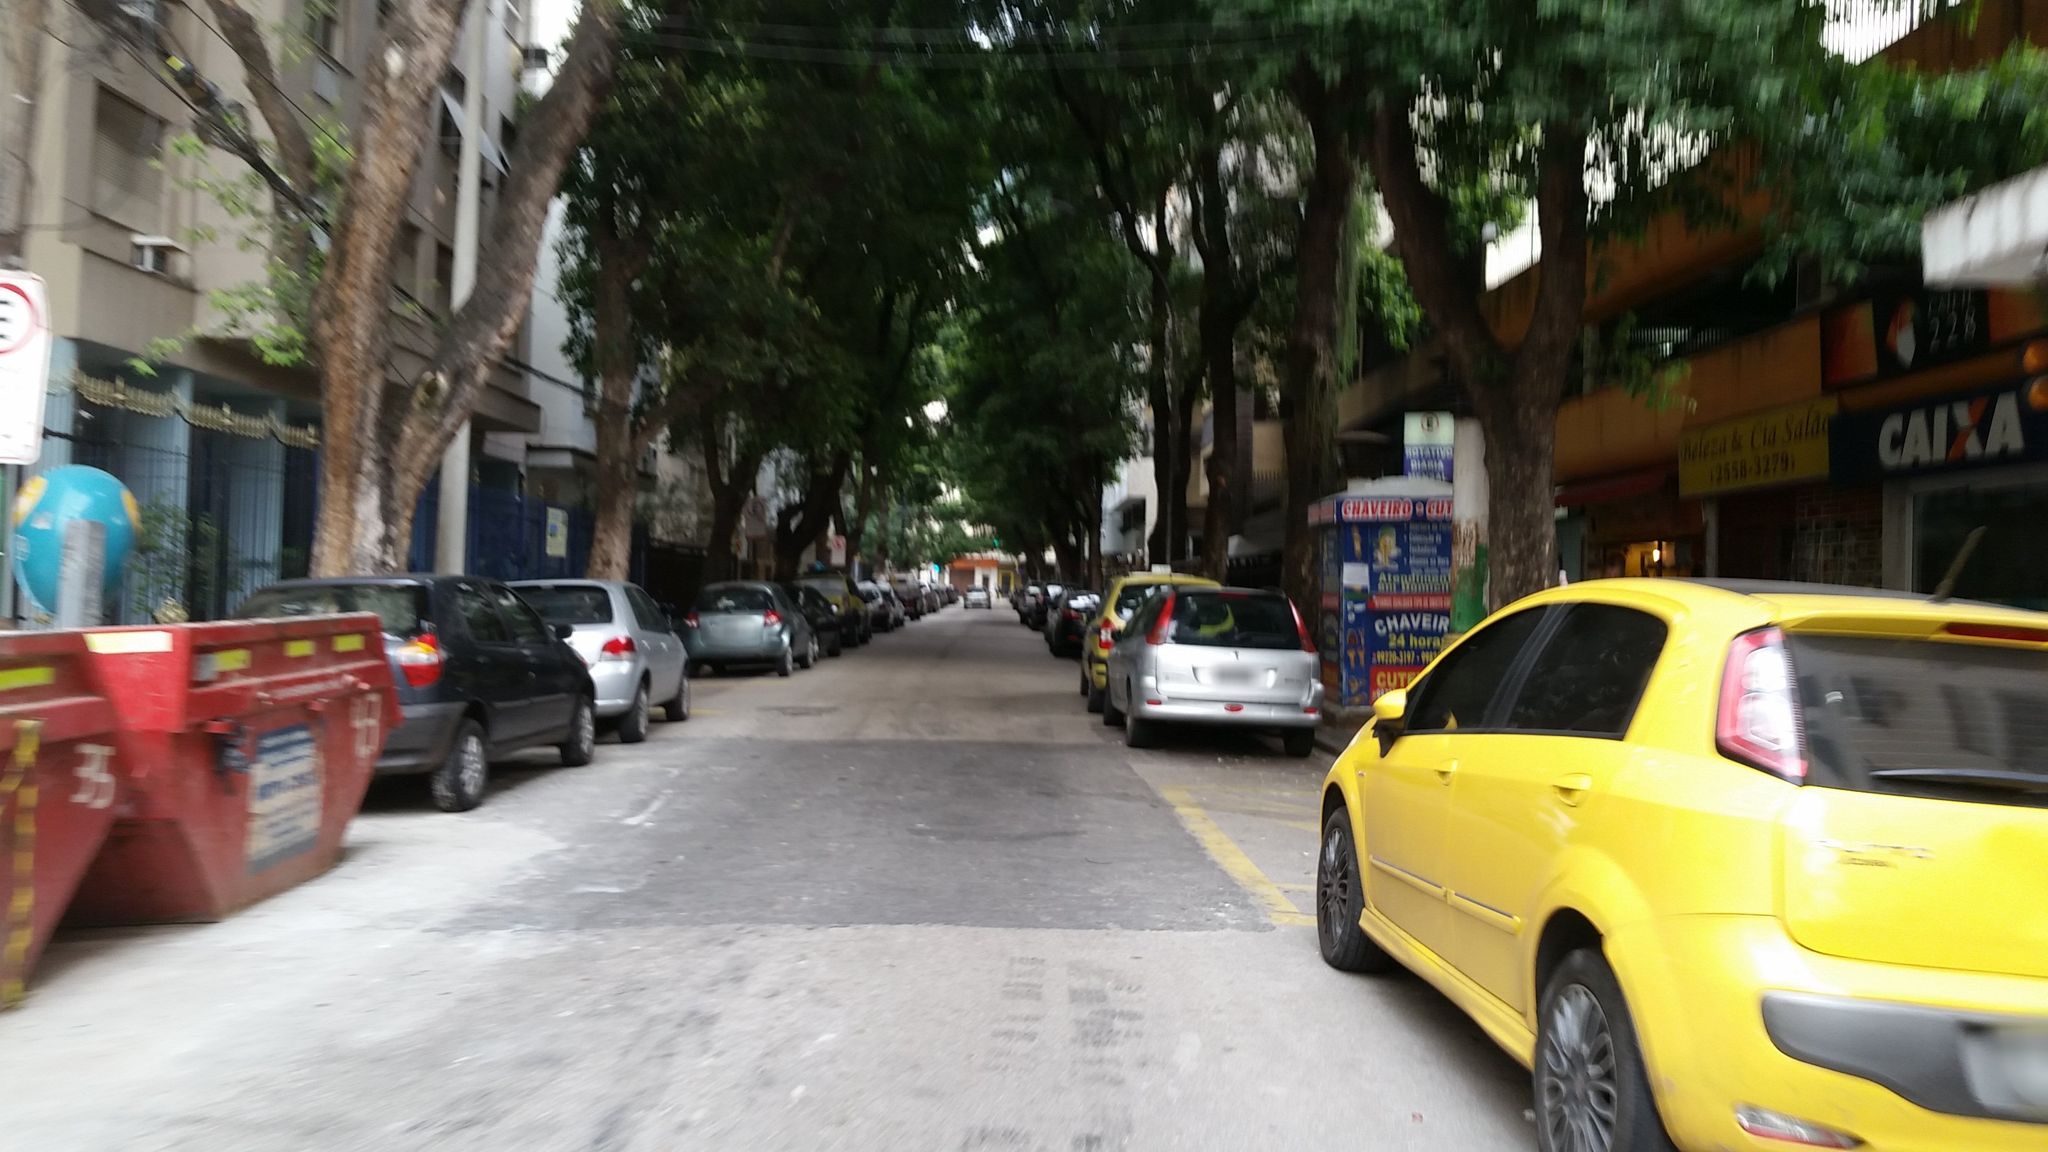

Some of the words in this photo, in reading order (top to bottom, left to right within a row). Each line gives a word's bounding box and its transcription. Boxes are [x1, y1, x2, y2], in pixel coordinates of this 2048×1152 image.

[1732, 426, 1743, 450] &
[1749, 418, 1777, 449] Cia
[1878, 391, 2025, 471] CAIXA
[1405, 447, 1453, 460] ROTATIVO
[1341, 497, 1413, 521] CHAVEIRO
[1374, 613, 1450, 636] CHAVEIR
[1389, 633, 1405, 649] 24
[1409, 633, 1444, 650] hora
